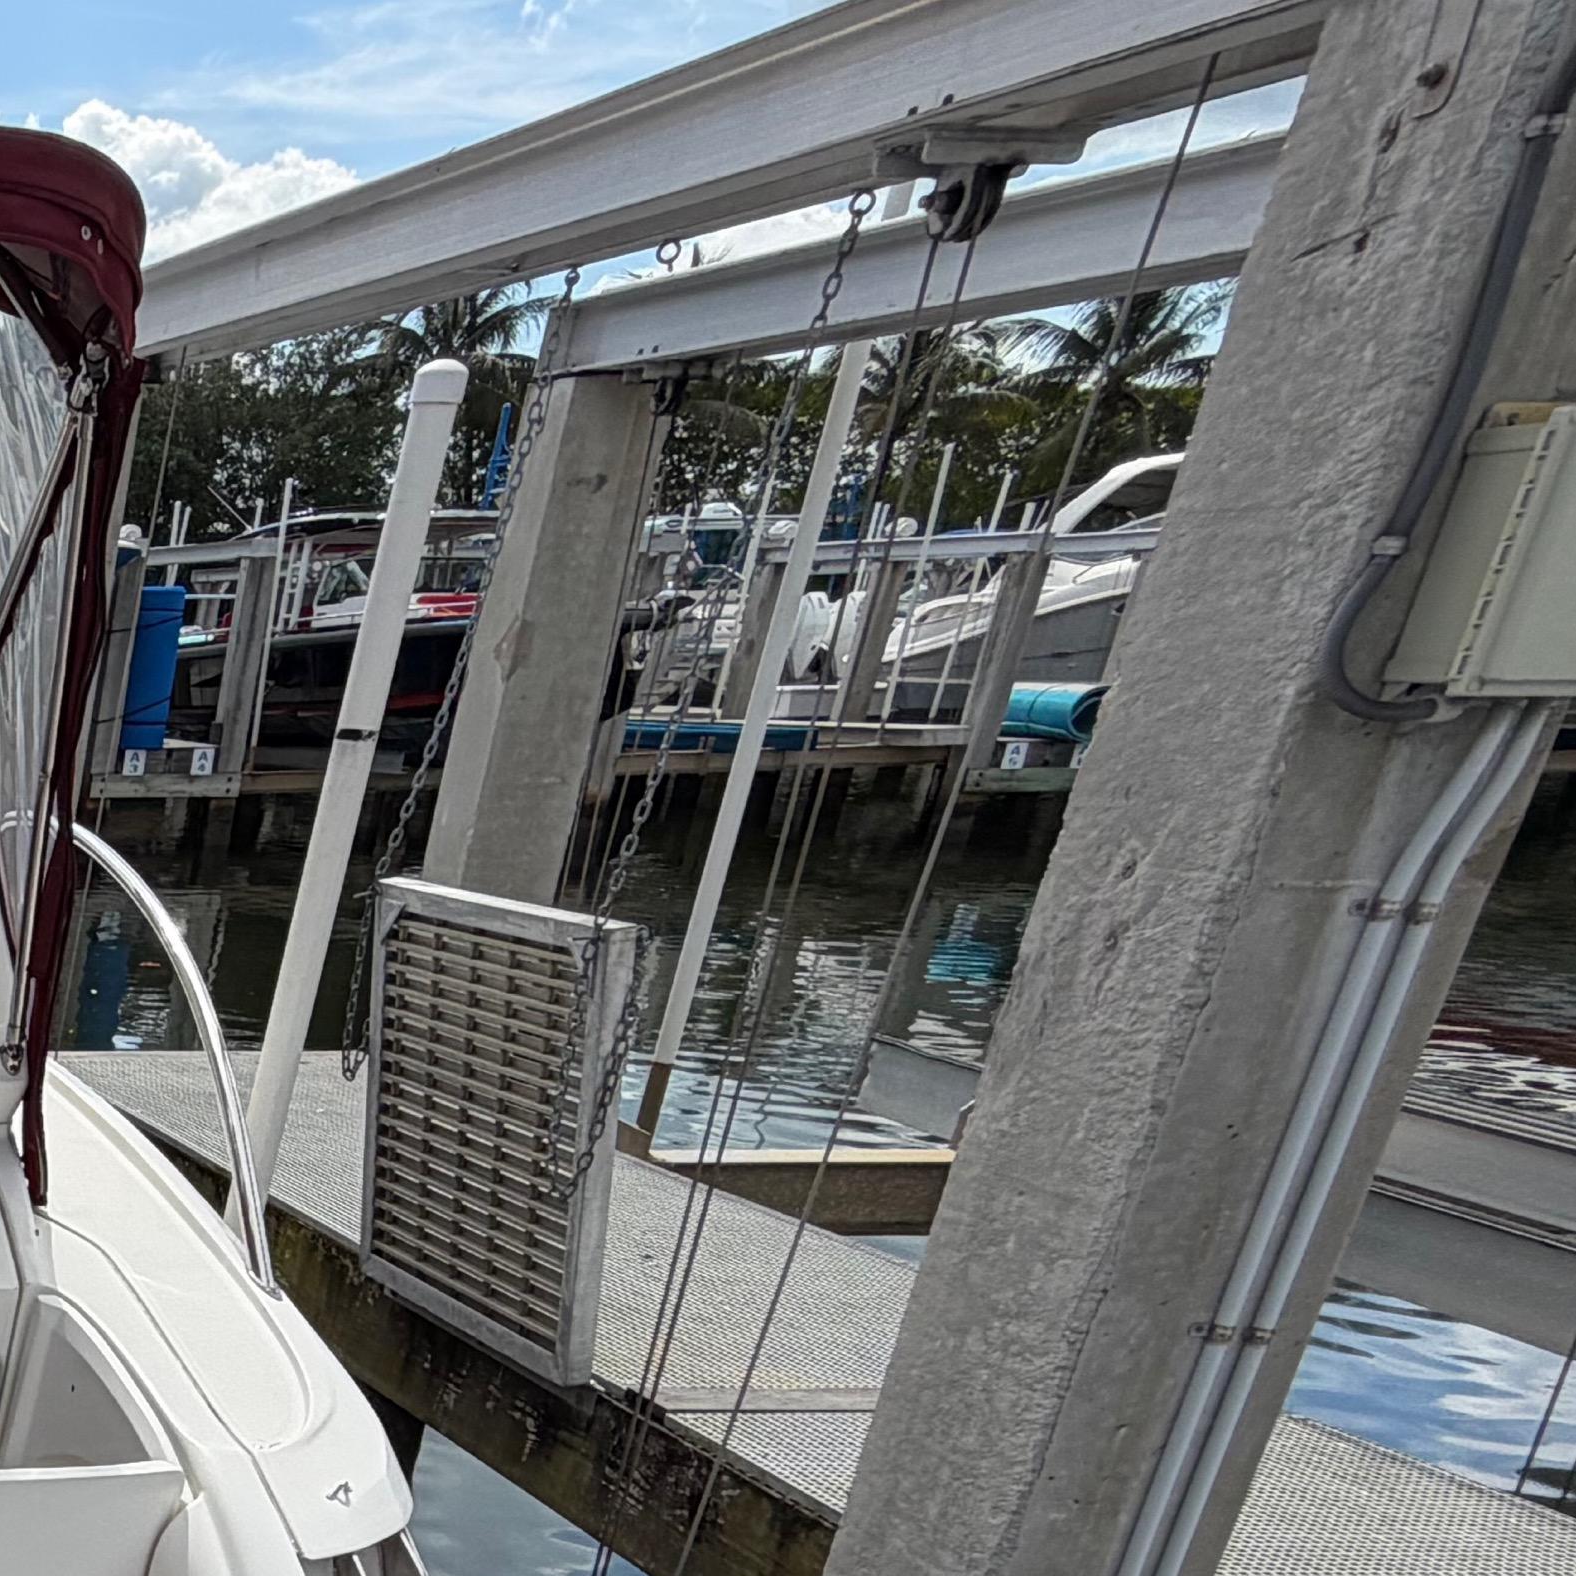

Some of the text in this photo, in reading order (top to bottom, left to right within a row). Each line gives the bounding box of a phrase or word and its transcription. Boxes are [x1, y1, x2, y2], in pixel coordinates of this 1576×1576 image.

[1010, 745, 1021, 756] A
[129, 751, 140, 763] A
[198, 751, 209, 763] A
